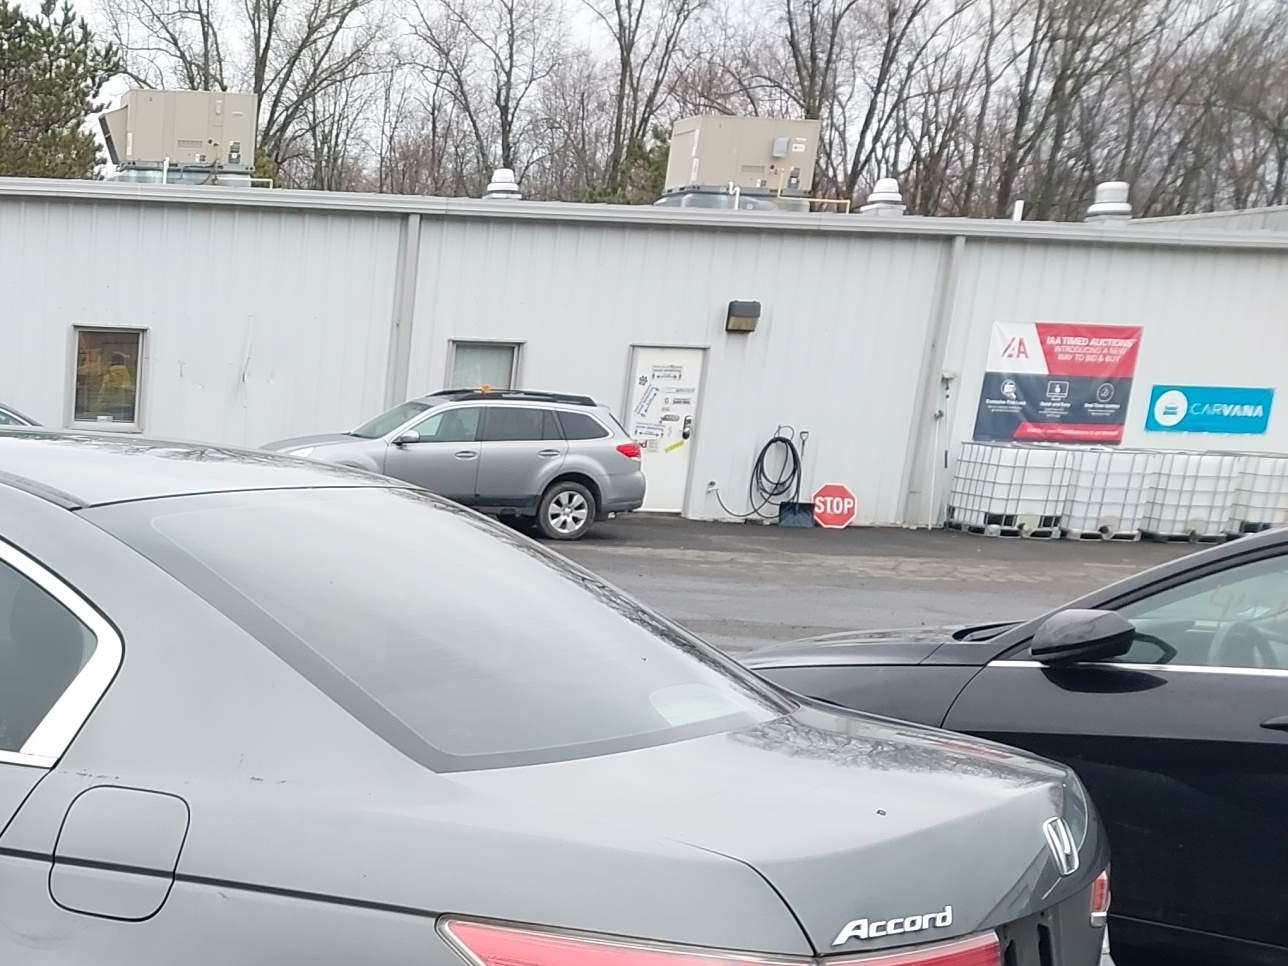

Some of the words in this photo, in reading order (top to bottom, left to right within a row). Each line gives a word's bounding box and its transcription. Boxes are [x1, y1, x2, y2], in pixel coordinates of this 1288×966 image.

[1189, 403, 1264, 417] CARVANA
[814, 496, 854, 515] STOP
[831, 905, 953, 946] Accord
